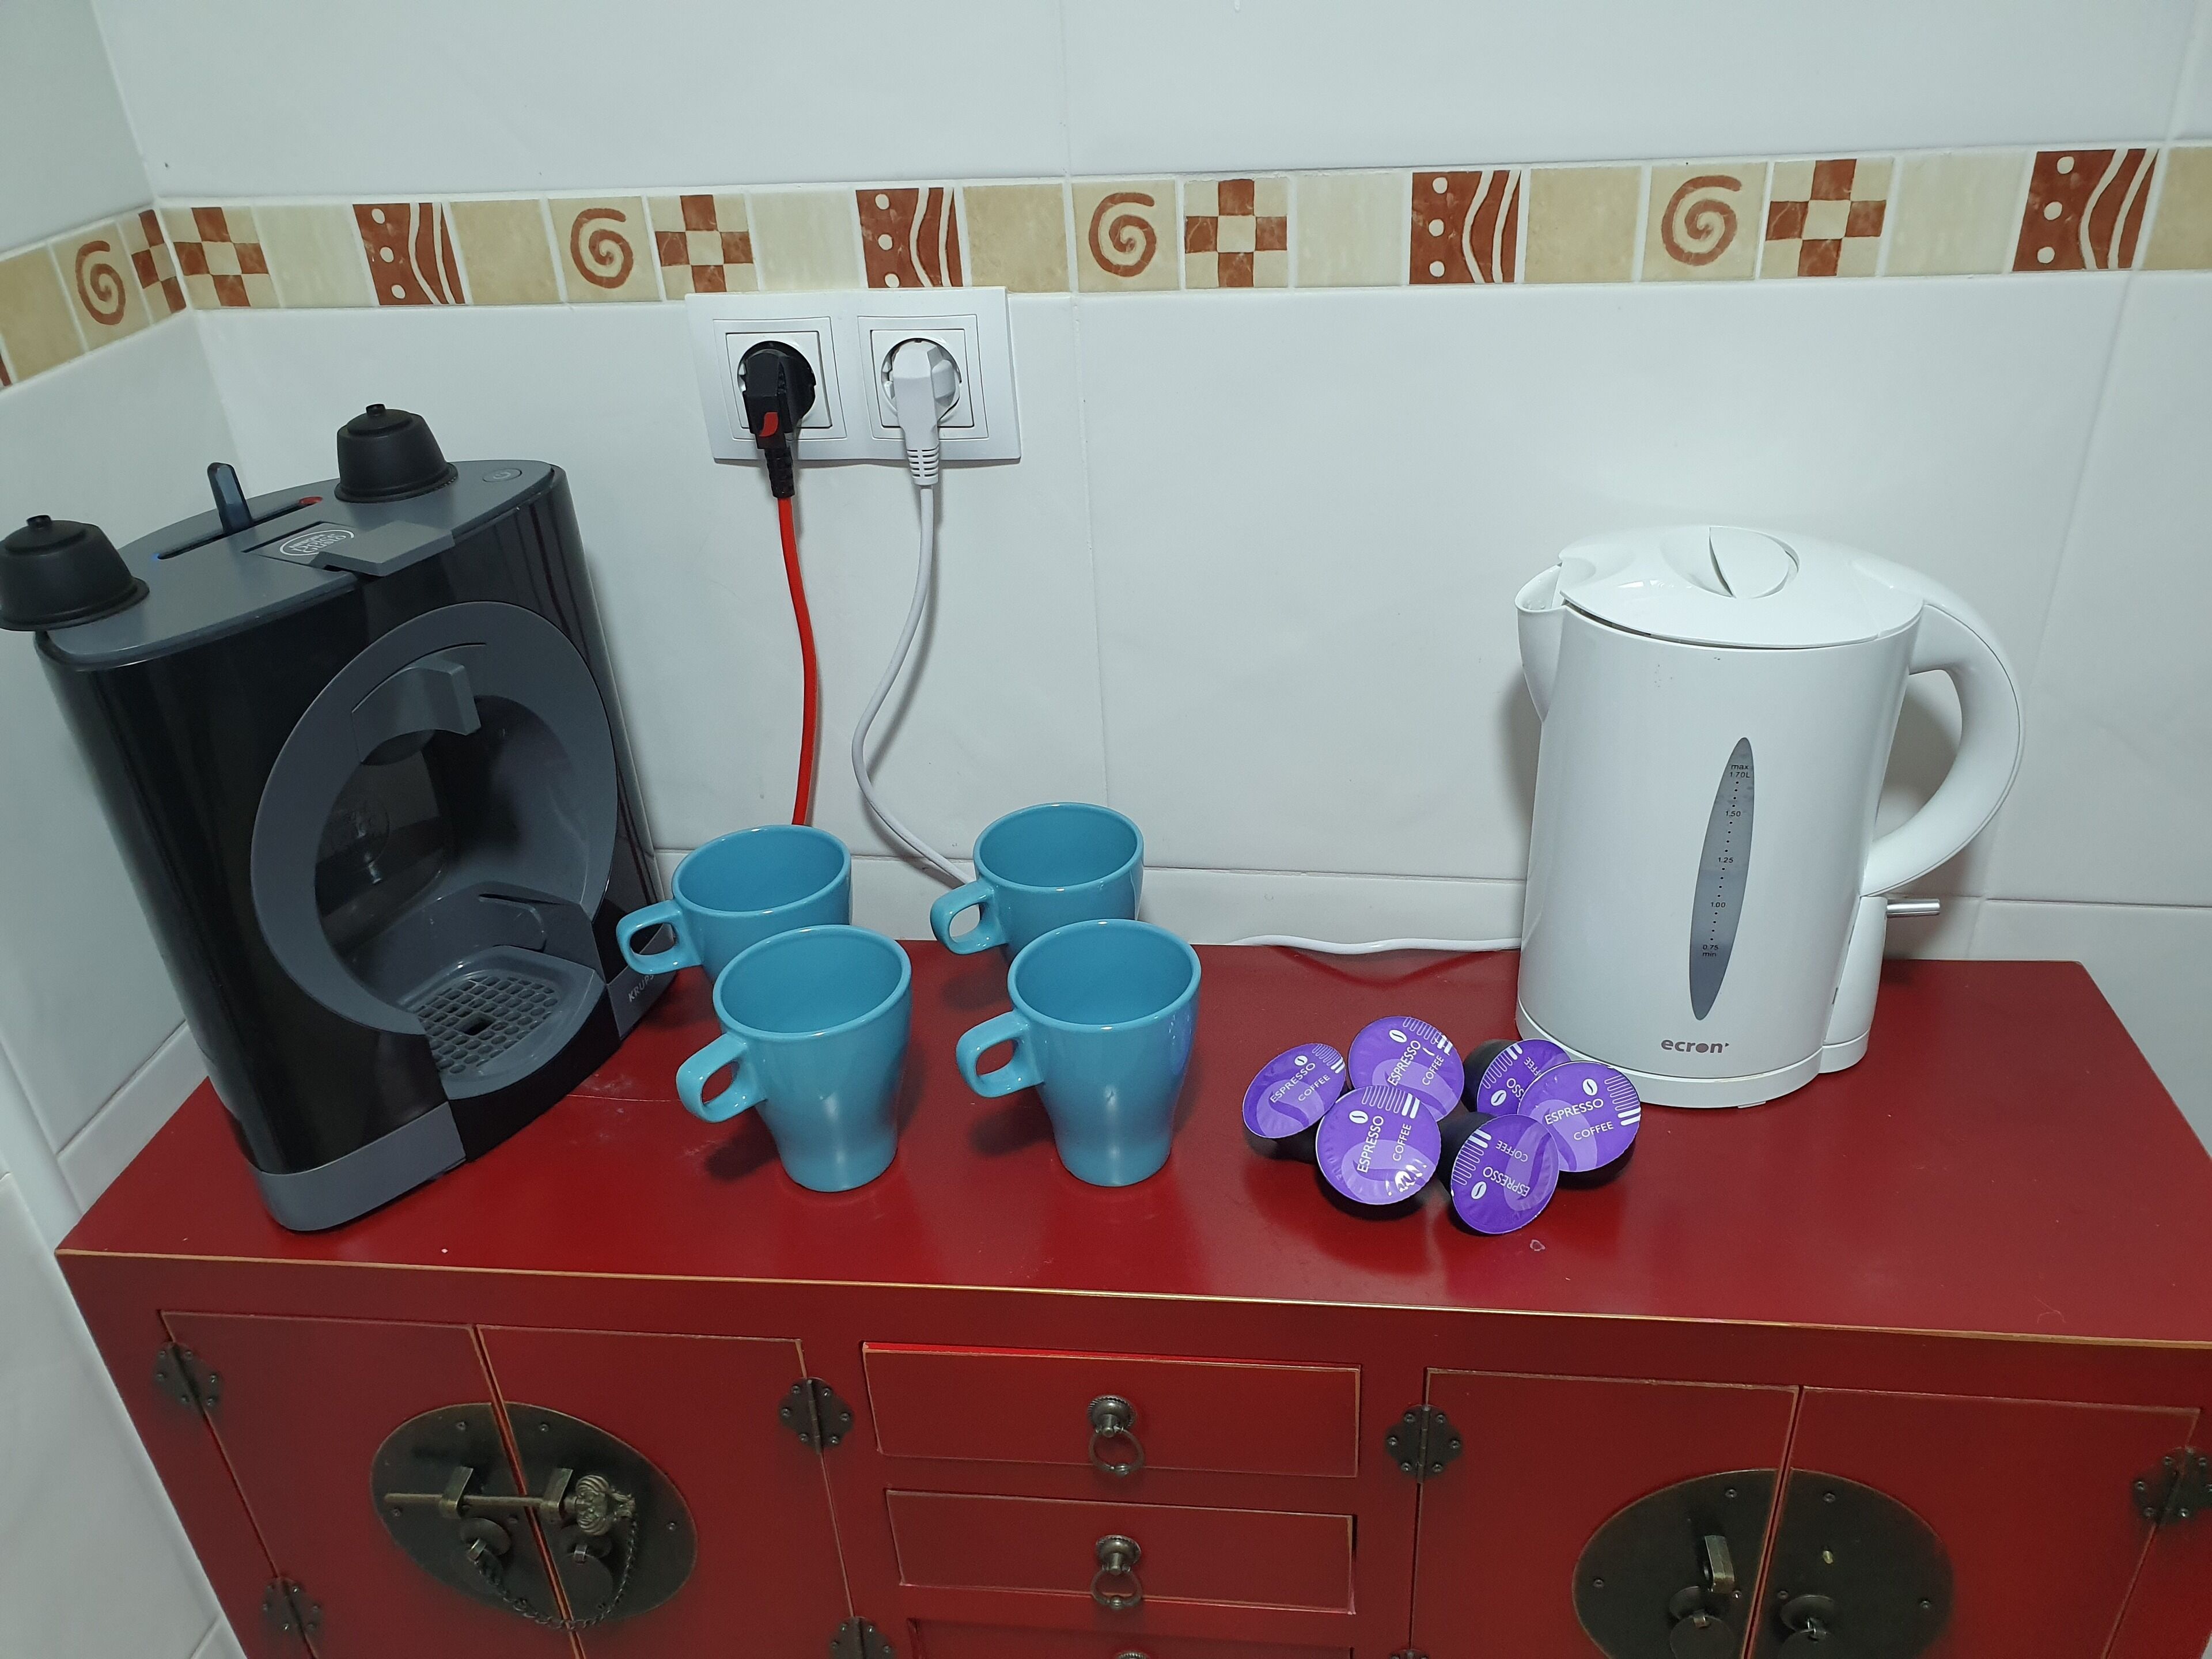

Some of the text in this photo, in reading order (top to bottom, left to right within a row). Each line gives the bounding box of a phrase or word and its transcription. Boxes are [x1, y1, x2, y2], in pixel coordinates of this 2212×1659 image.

[1661, 1040, 1724, 1053] ecron
[1387, 1040, 1421, 1086] ESPRESSO
[1422, 1055, 1444, 1085] COFFEE
[1524, 1057, 1541, 1075] FFEE
[1270, 1063, 1315, 1103] ESPRESSO
[1298, 1074, 1331, 1101] COFFEE
[1544, 1099, 1604, 1125] ESPRESSO
[1357, 1116, 1384, 1173] ESPRESSO
[1392, 1123, 1411, 1161] COFFEE
[1573, 1122, 1614, 1141] COFFEE
[1495, 1140, 1528, 1162] COFFEE
[1483, 1166, 1530, 1198] ESPRESSO
